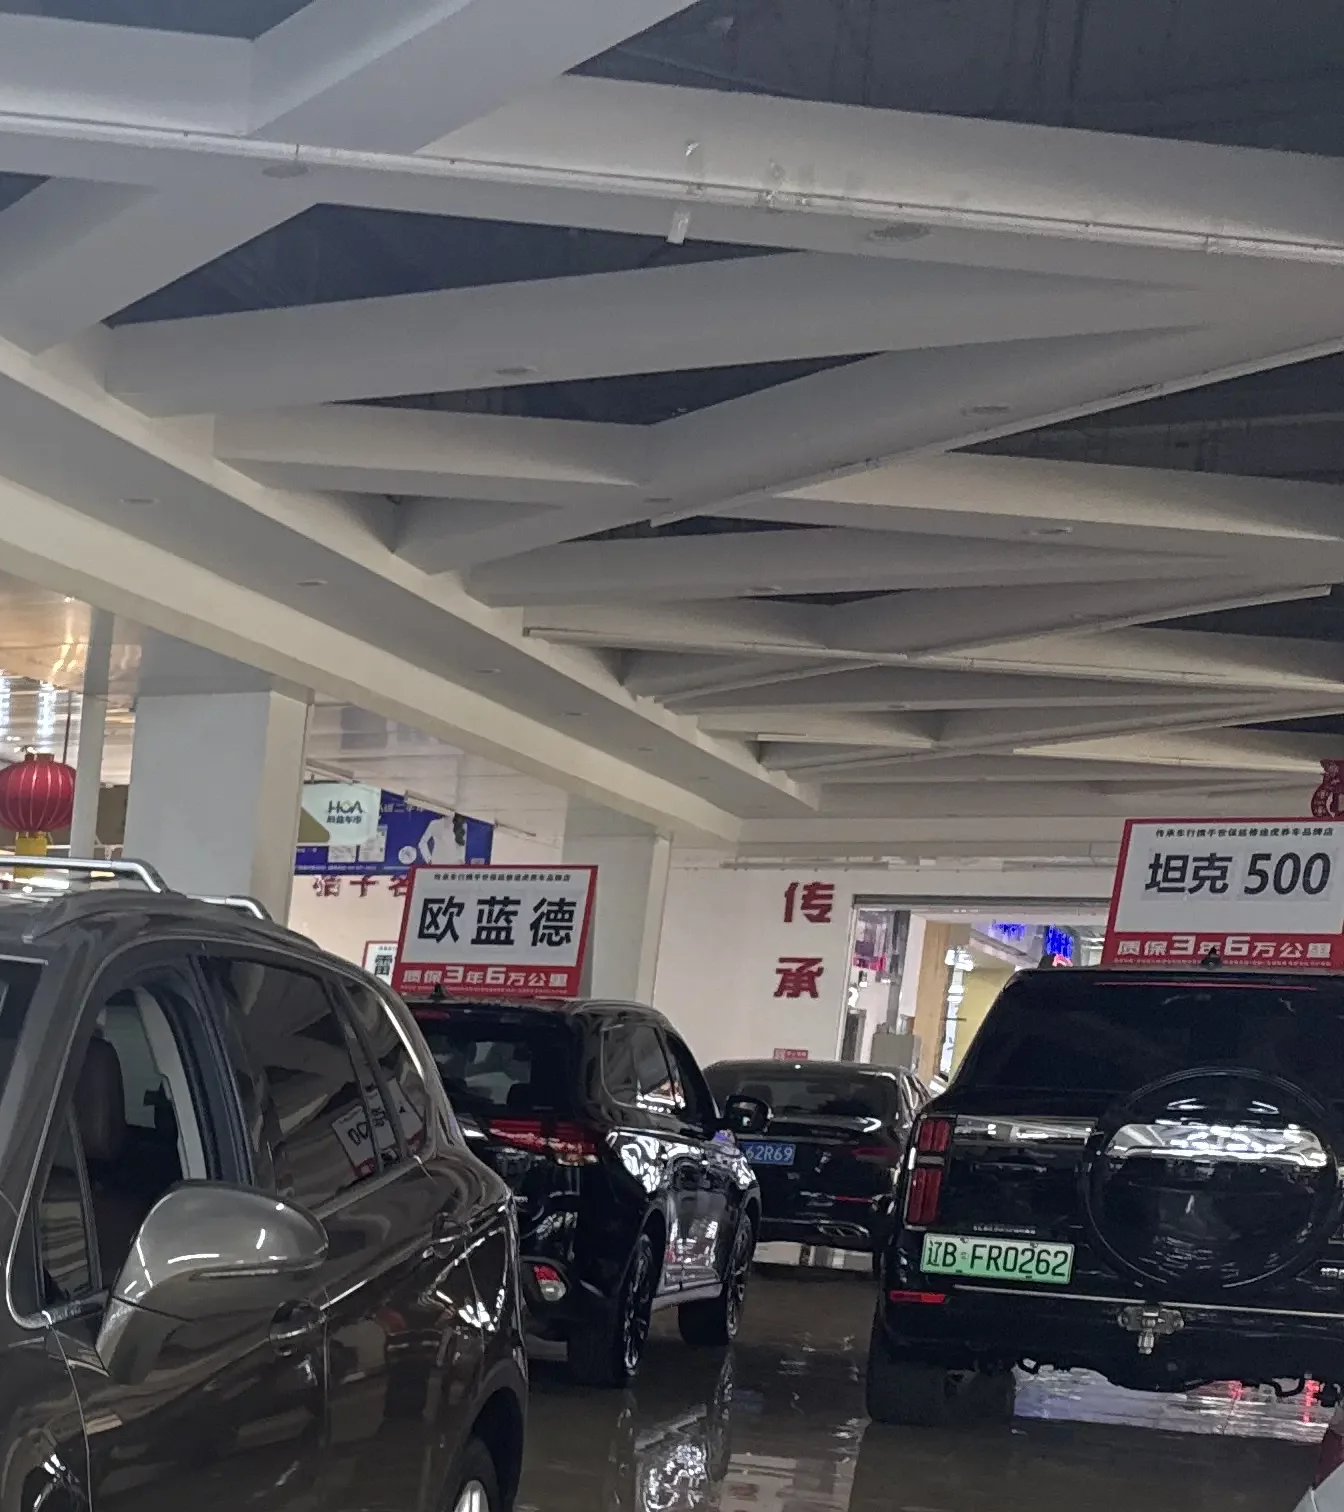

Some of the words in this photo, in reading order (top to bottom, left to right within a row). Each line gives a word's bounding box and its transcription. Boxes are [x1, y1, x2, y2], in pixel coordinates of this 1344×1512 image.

[1144, 852, 1234, 894] 坦克
[1243, 851, 1332, 896] 500
[417, 895, 578, 948] 欧蓝德
[773, 881, 836, 999] 传承
[925, 1240, 958, 1268] 辽B
[969, 1243, 1069, 1277] FR0262
